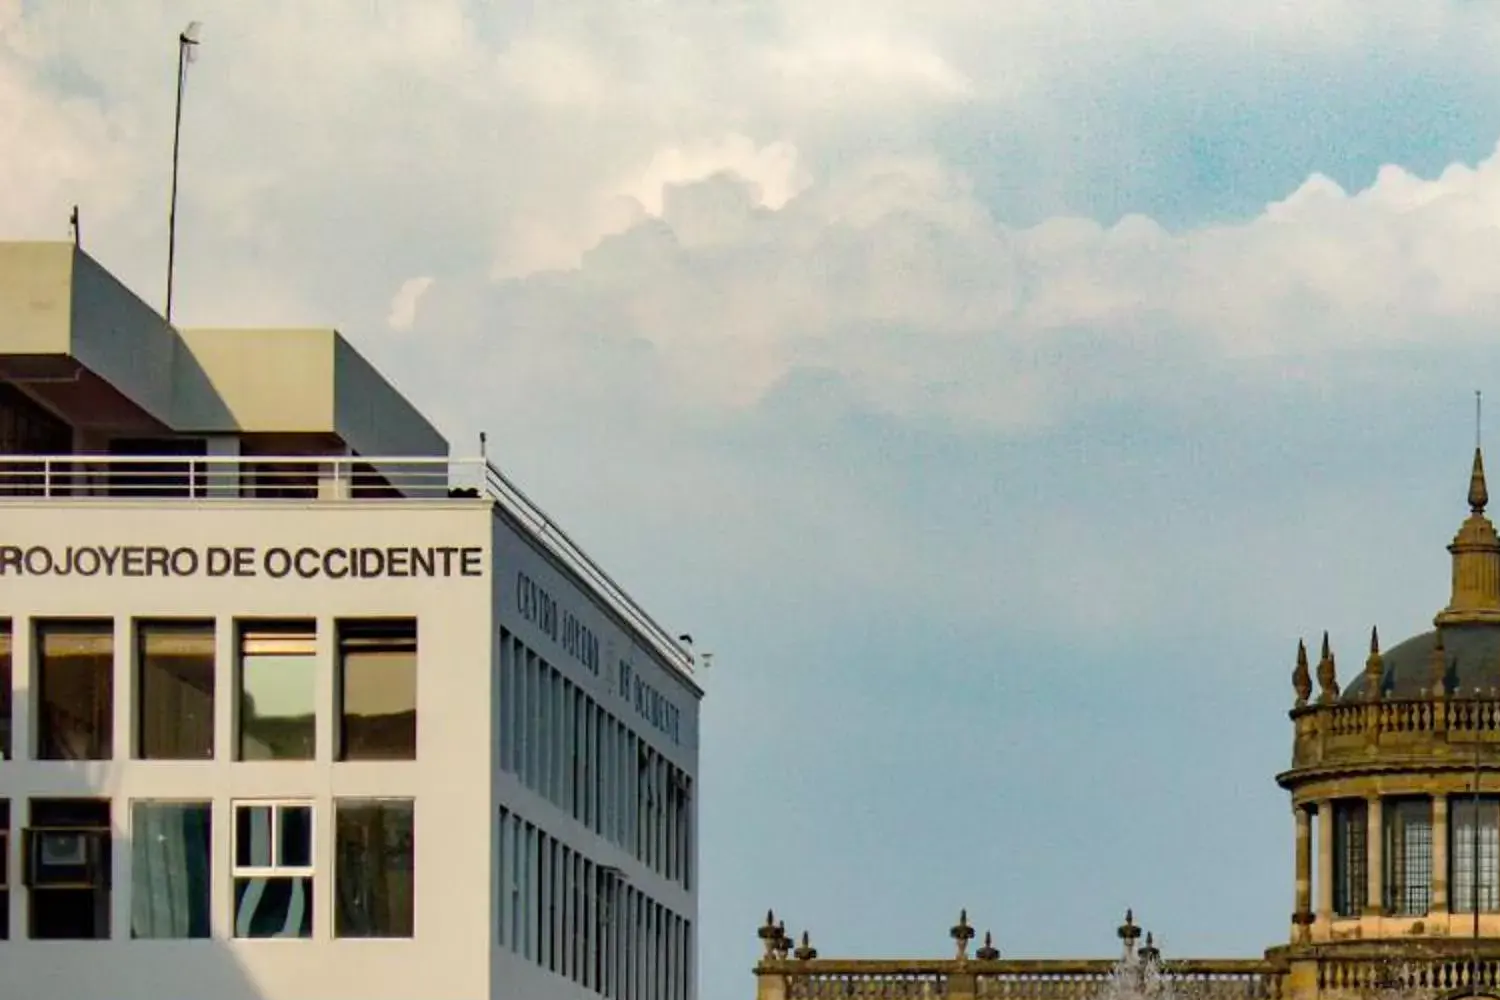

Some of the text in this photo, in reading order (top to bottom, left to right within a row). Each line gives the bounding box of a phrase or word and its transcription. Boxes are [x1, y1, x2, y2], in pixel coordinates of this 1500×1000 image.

[206, 547, 256, 576] DE
[263, 547, 483, 579] OCCIDENTE
[516, 570, 680, 745] CENTRO JOYERO DE OCCIDENTE
